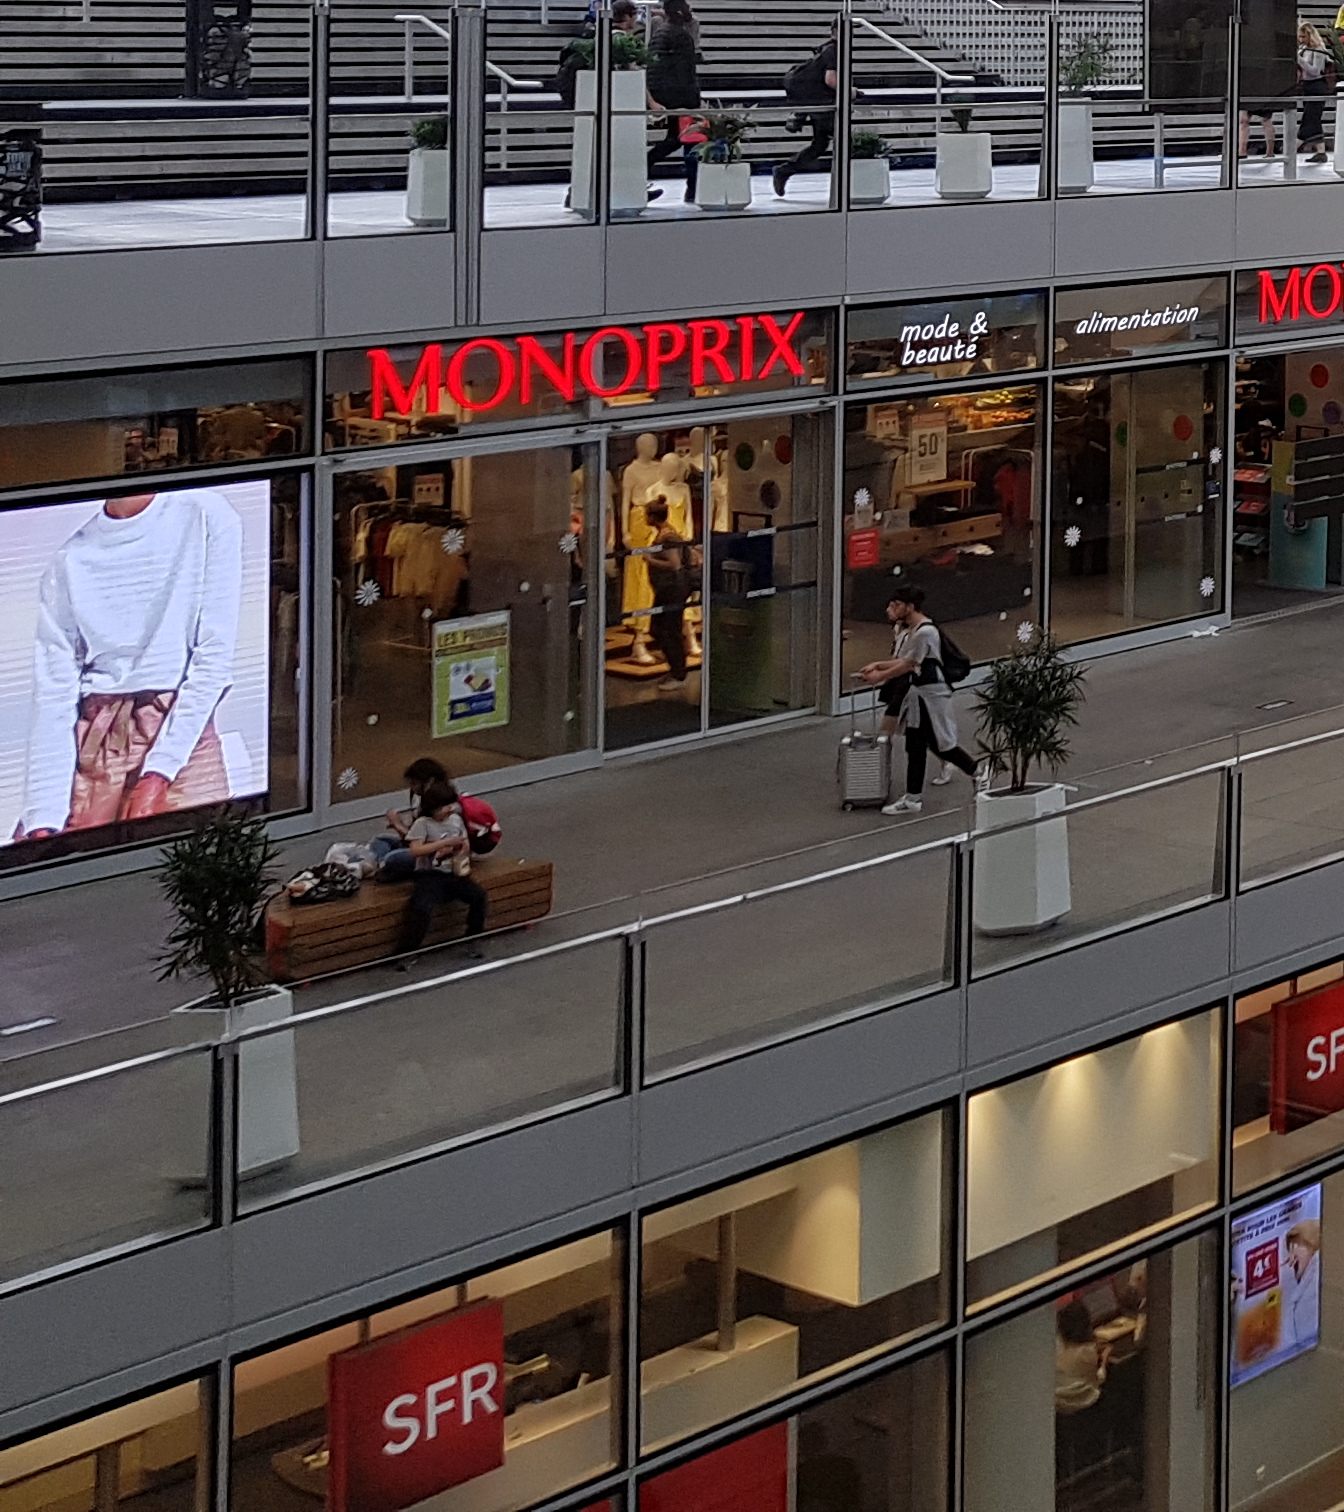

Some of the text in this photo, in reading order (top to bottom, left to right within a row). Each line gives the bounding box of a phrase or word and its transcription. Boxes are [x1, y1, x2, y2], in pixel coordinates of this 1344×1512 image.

[900, 310, 989, 343] mode &
[1076, 303, 1200, 336] alimentation
[366, 311, 805, 421] MONOPRIX
[902, 334, 980, 367] beauté
[380, 1360, 500, 1457] SFR
